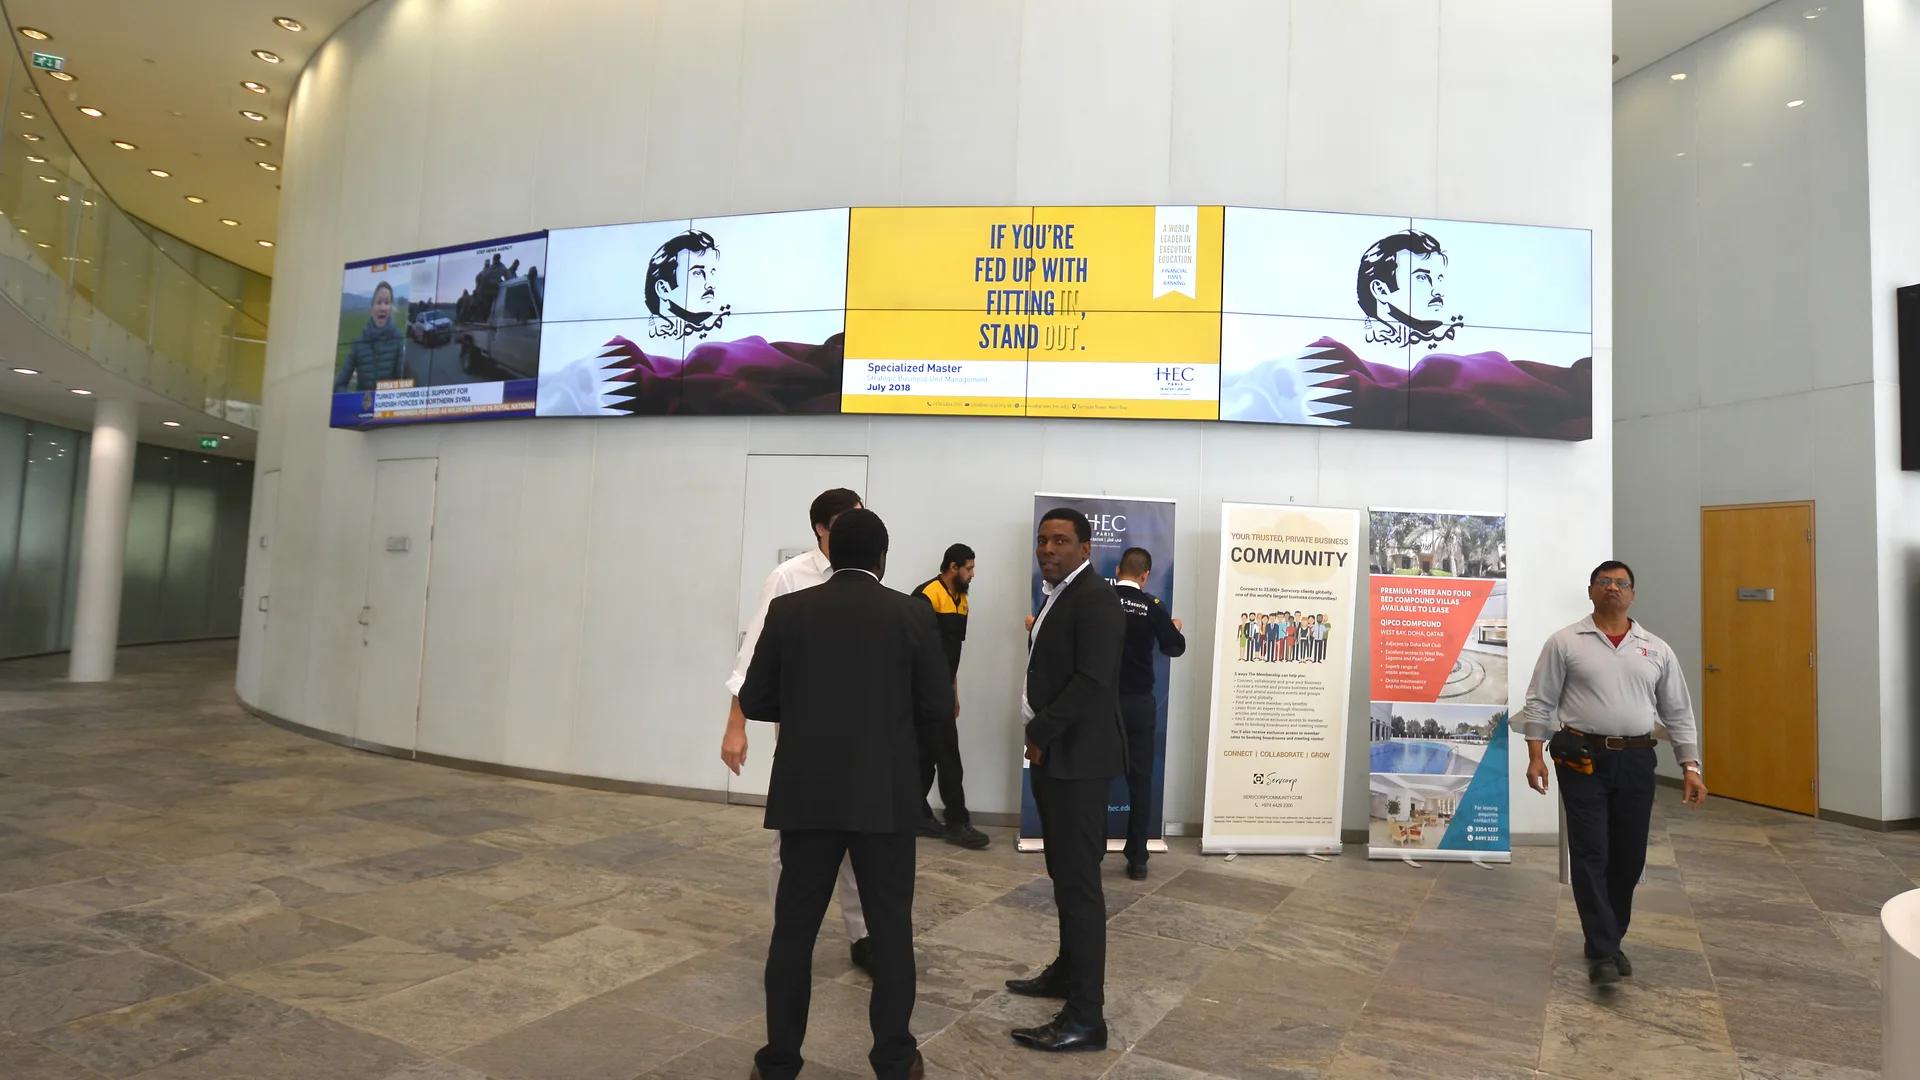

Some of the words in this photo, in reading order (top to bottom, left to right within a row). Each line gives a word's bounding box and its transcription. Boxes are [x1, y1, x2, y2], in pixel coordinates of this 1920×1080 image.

[1162, 224, 1167, 232] A
[1168, 224, 1190, 232] WORLD
[990, 224, 1006, 249] IF
[1160, 234, 1183, 243] LEADER
[1184, 234, 1191, 243] IN
[1160, 245, 1192, 254] EXECUTIVE
[1158, 256, 1192, 264] EDUCATION
[974, 257, 1006, 282] FED
[1012, 257, 1036, 283] UP
[1042, 258, 1088, 284] WITH
[986, 290, 1055, 316] FITTING
[978, 324, 1038, 349] STAND
[868, 362, 924, 374] Specialized
[928, 363, 962, 373] Master
[944, 376, 988, 384] Management
[1155, 367, 1194, 382] HEC
[396, 390, 420, 398] OPPOSES
[432, 388, 456, 396] SUPPORT
[866, 384, 886, 392] July
[375, 400, 397, 408] KURDISH
[426, 397, 454, 406] NORTHERN
[1085, 513, 1127, 532] HEC
[1251, 533, 1284, 543] TRUSTED,
[1285, 535, 1313, 544] PRIVATE
[1314, 537, 1349, 546] BUSINESS
[1231, 546, 1348, 567] COMMUNITY
[1380, 604, 1417, 612] AVAILABLE
